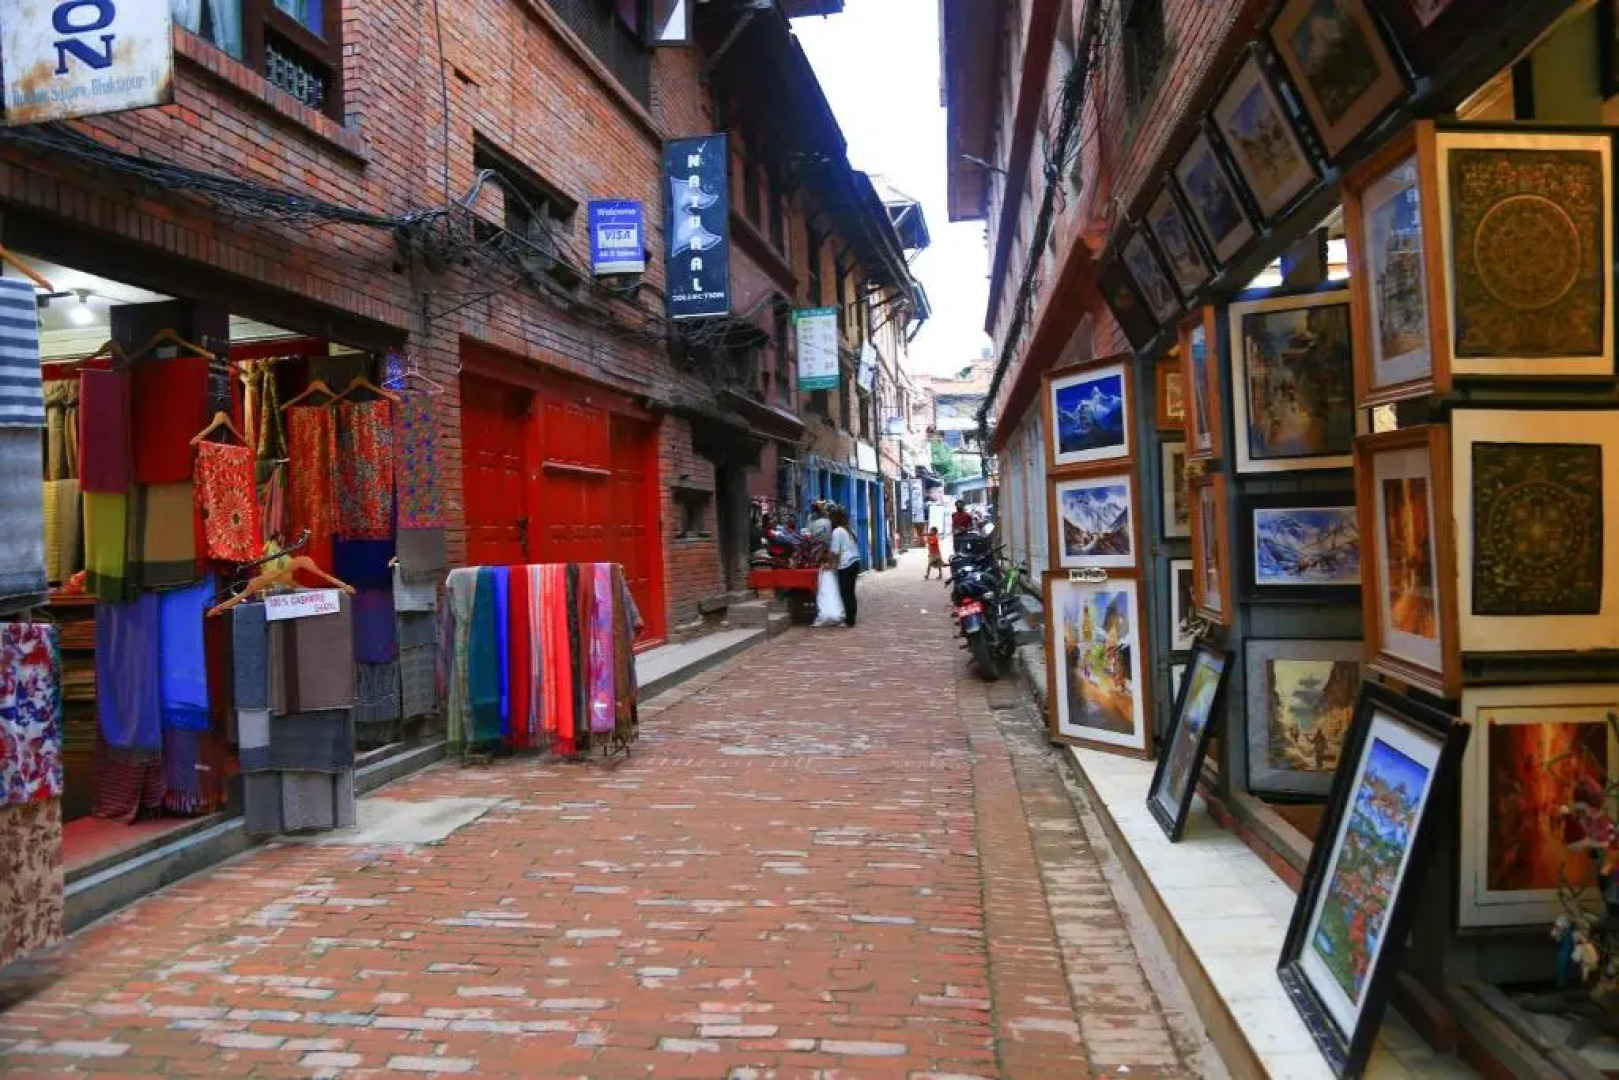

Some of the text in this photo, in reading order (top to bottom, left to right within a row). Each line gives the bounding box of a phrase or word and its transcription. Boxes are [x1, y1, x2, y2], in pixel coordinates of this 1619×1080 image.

[597, 208, 637, 216] Welcome
[687, 154, 703, 292] NATURAL
[605, 230, 631, 240] VISA
[671, 291, 725, 302] COLLECTION
